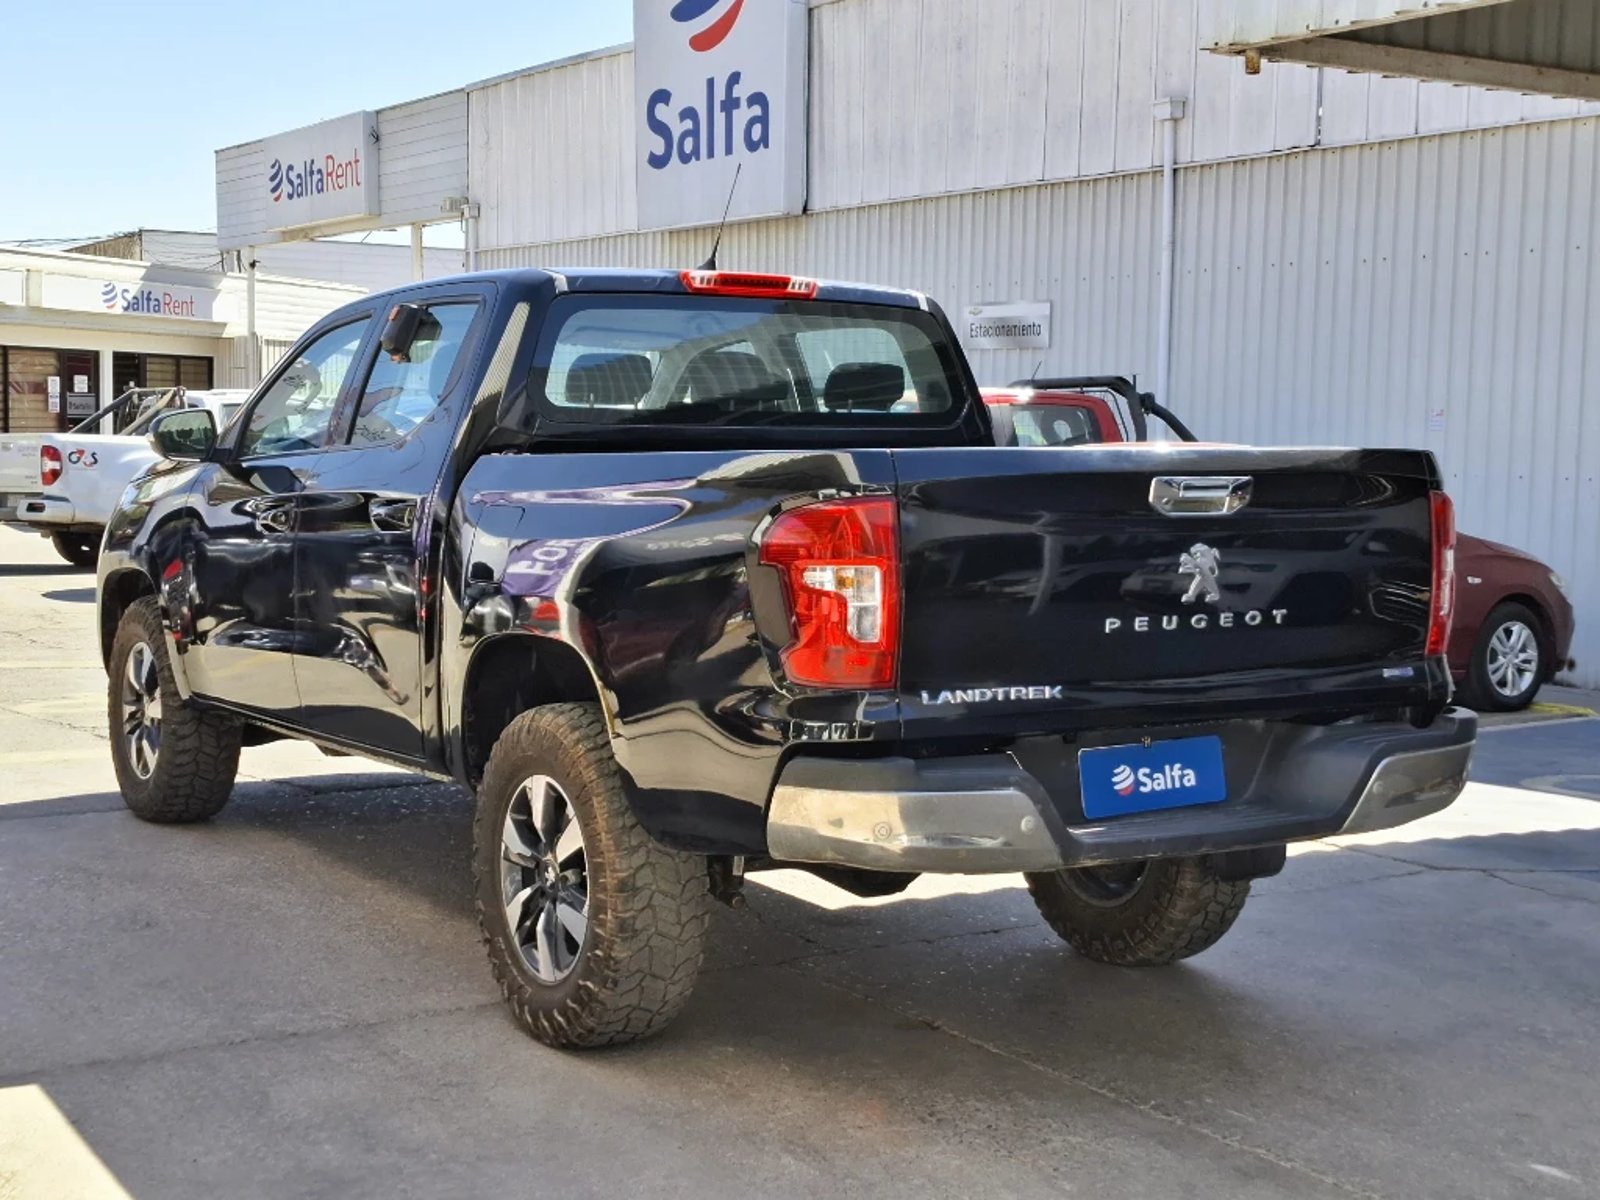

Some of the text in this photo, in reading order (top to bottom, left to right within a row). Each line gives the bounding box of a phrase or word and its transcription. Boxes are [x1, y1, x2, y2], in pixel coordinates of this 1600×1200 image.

[646, 71, 769, 170] Salfa
[286, 148, 361, 200] SalfaRent
[121, 289, 195, 317] SalfaRent
[969, 321, 1042, 339] Estacionamiento
[1105, 609, 1287, 633] PEUGEOT
[921, 685, 1063, 705] LANDTREK
[1137, 763, 1197, 793] Salfa
